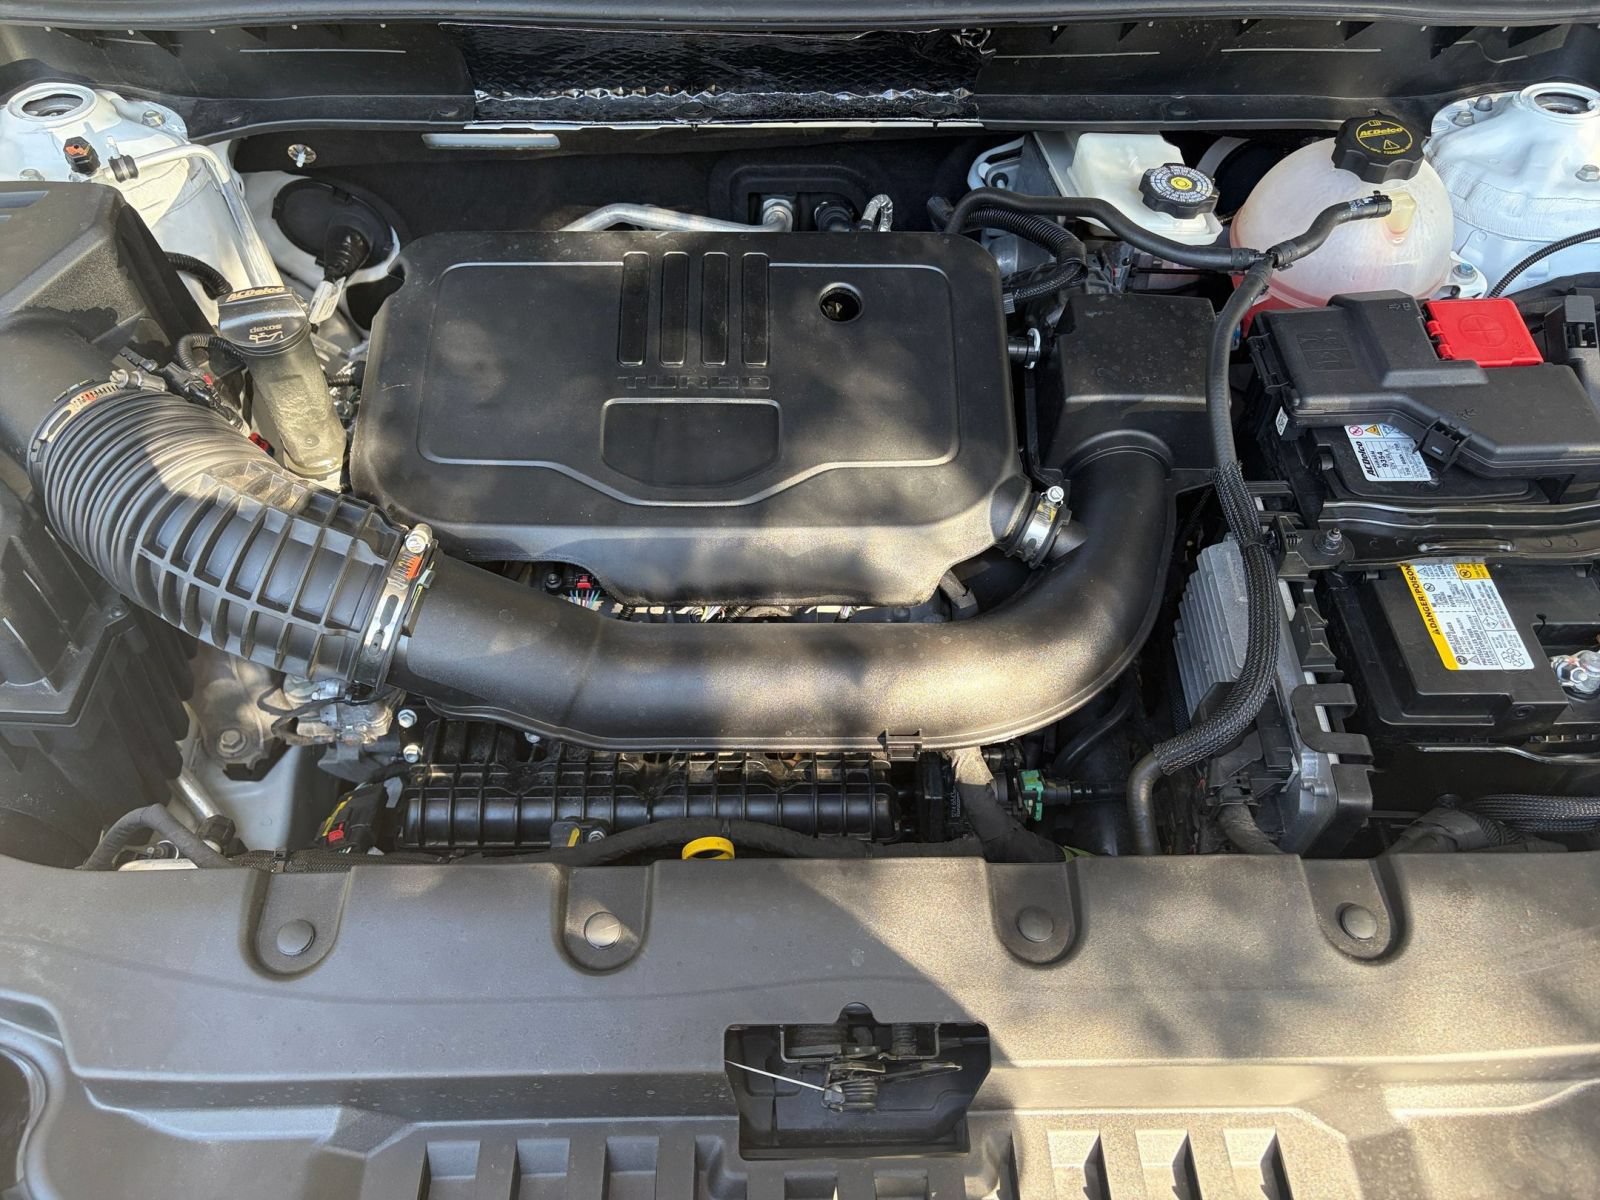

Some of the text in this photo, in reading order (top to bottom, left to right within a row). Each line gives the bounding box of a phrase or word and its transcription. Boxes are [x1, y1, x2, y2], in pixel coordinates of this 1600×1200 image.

[1360, 127, 1403, 137] ACDelco
[226, 287, 286, 303] ACDelco
[249, 324, 282, 334] dexos
[617, 375, 770, 389] TURBO
[1356, 441, 1376, 476] ACDelco
[1377, 451, 1389, 467] 9354
